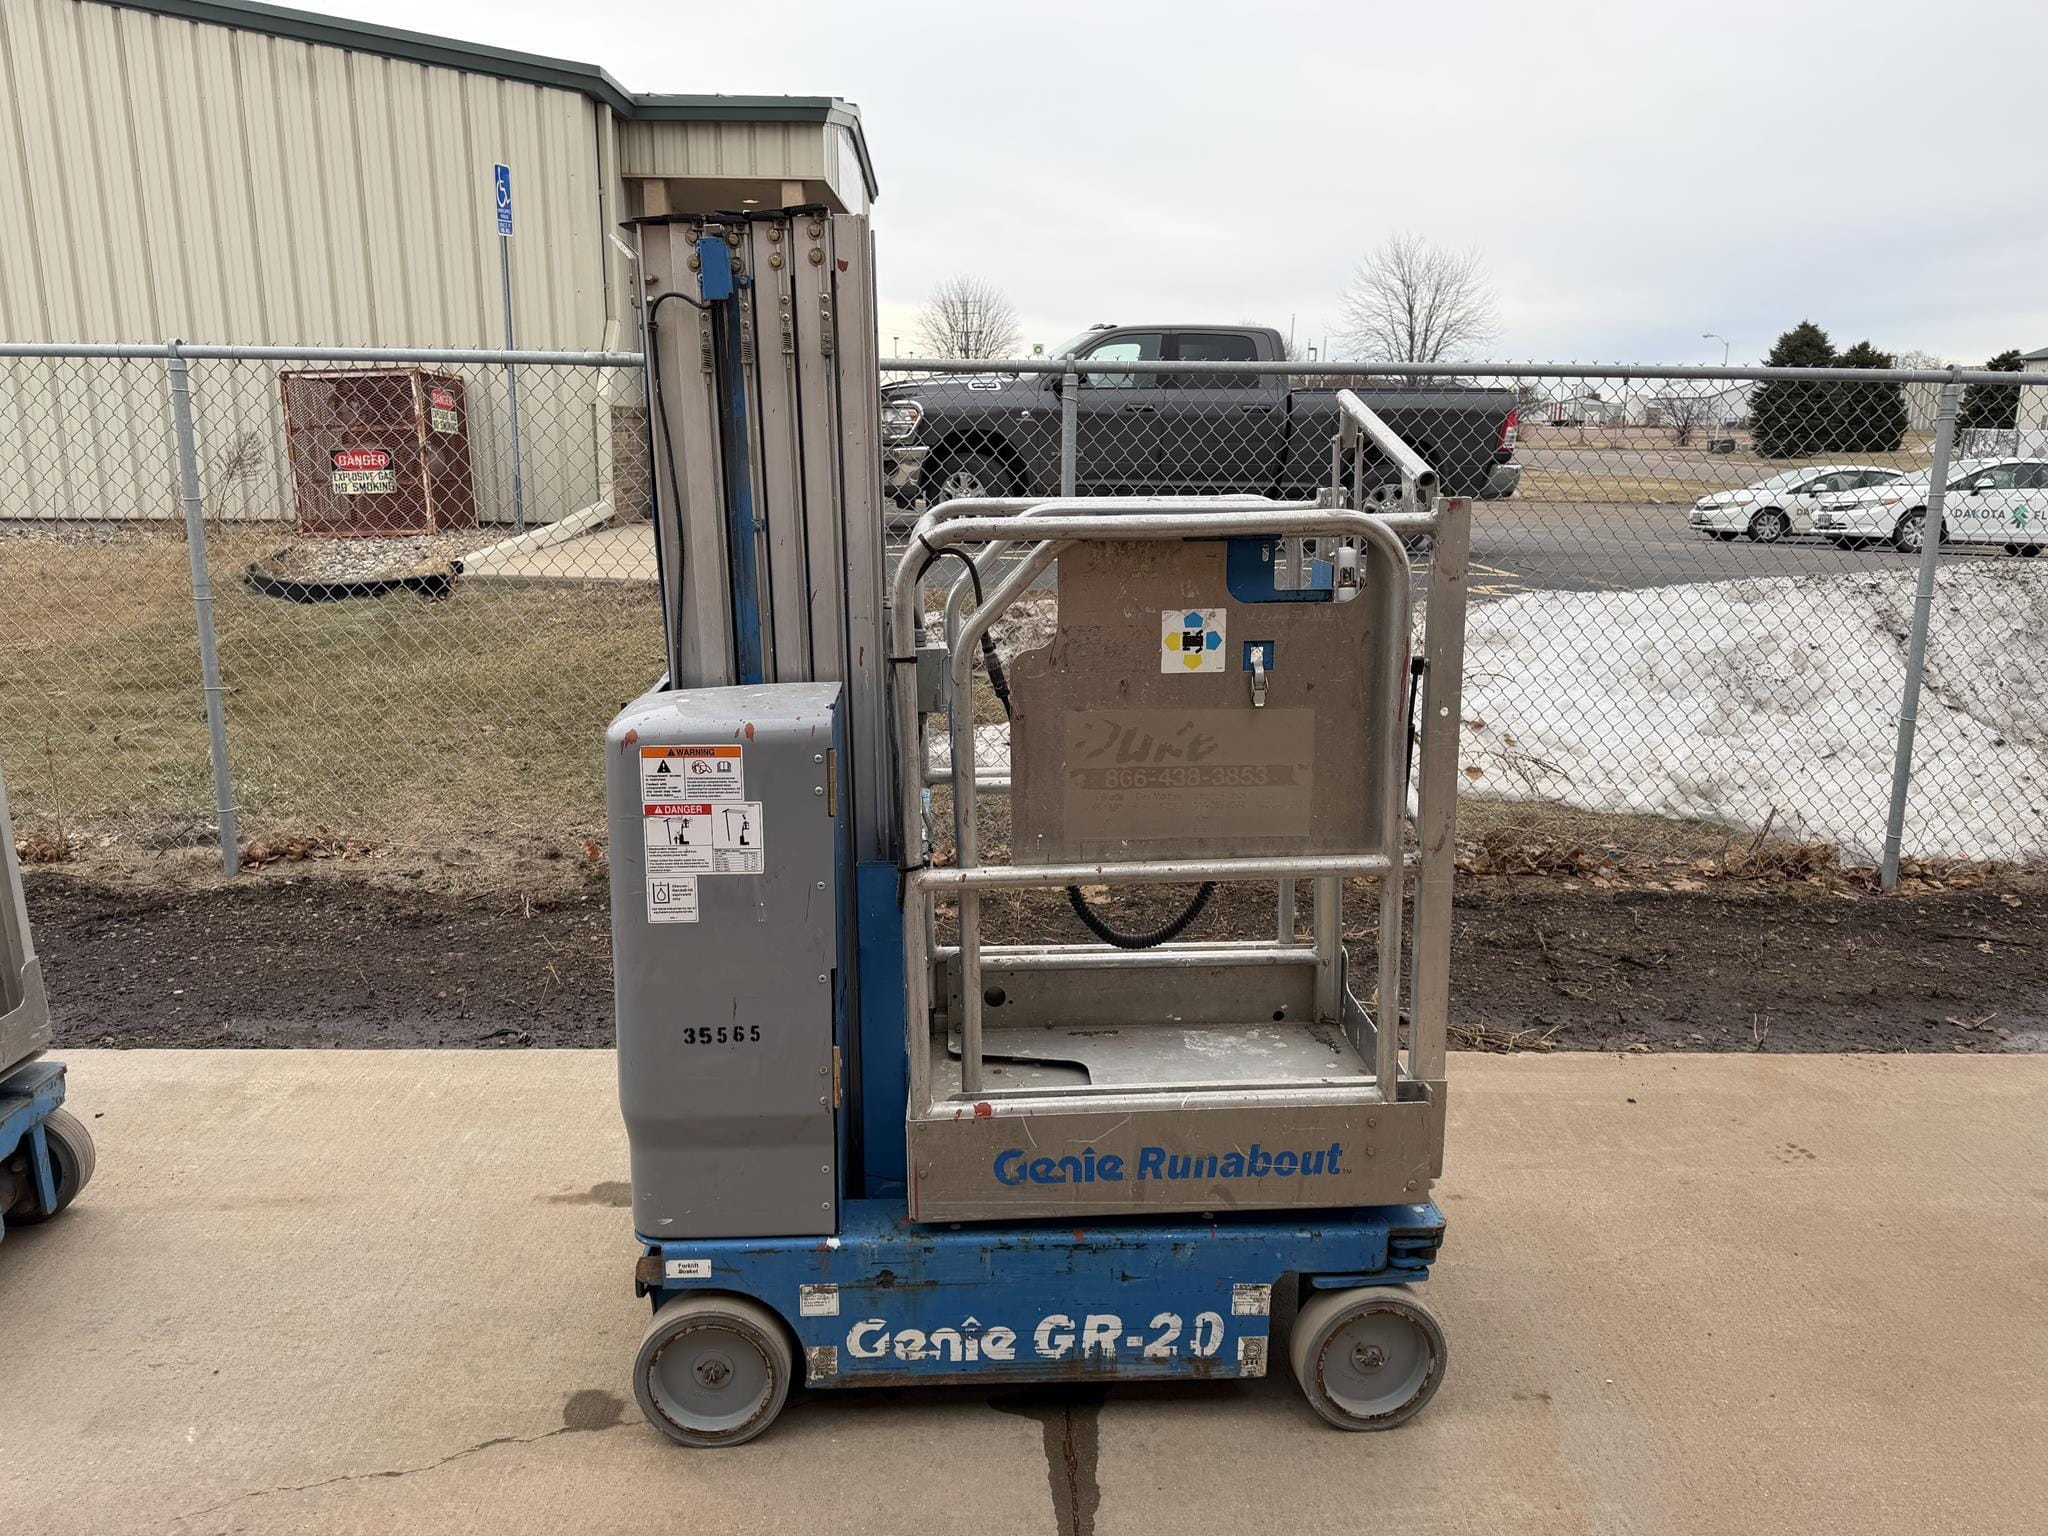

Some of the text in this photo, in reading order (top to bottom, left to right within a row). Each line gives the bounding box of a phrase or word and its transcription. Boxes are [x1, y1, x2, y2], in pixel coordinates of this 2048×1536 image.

[338, 454, 387, 467] DANGER
[333, 471, 395, 482] EXPLOSIVE GAS
[334, 482, 396, 493] NO SMOKING
[1955, 508, 2006, 519] DAKOTA
[676, 748, 715, 757] WARNING
[1104, 766, 1269, 788] 866-438-3853
[664, 805, 703, 815] DANGER
[683, 1025, 760, 1045] 35565
[1137, 1142, 1343, 1180] Runabout
[1033, 1311, 1225, 1361] GR-20
